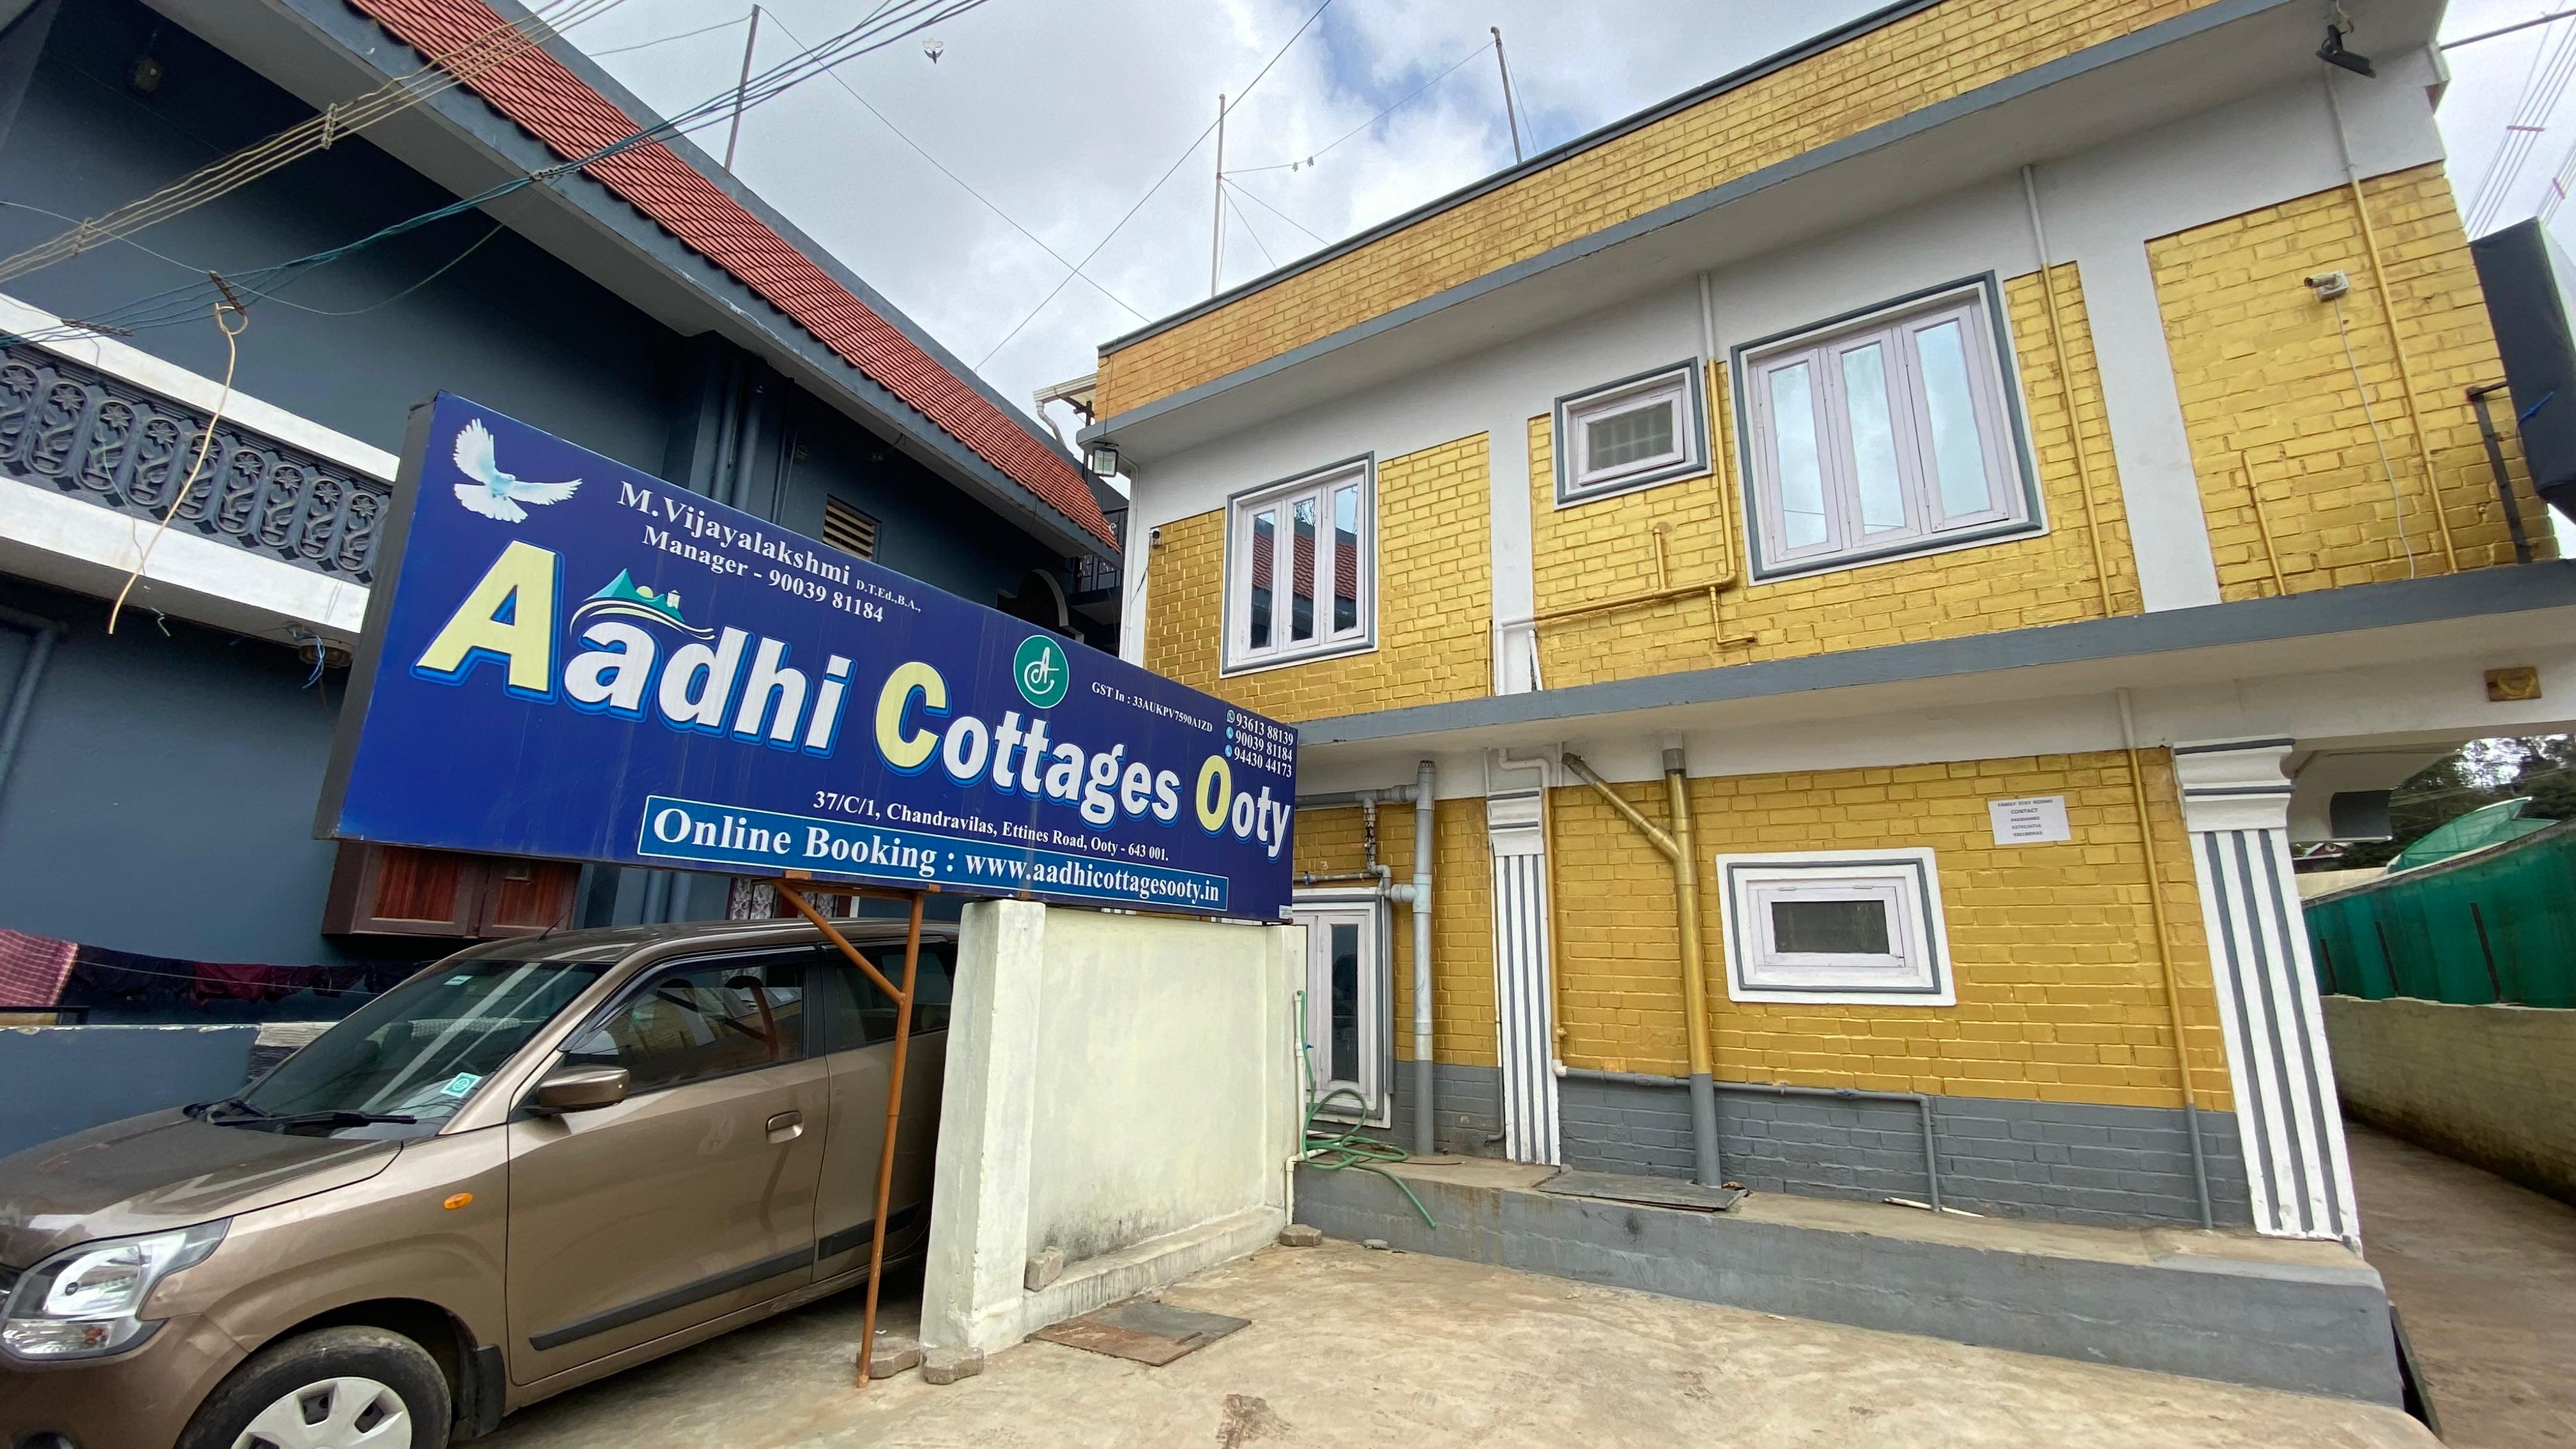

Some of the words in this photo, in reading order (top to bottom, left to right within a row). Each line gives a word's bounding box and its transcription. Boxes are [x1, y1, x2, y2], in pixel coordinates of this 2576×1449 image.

[617, 481, 850, 585] M.Vijayalakshmi
[642, 525, 748, 578] Manager
[768, 569, 827, 602] 90039
[832, 592, 883, 622] 81184
[414, 539, 855, 750] Aadhi
[875, 661, 1180, 825] Cottages
[1195, 755, 1291, 858] Ooty
[1091, 681, 1114, 698] GST
[1115, 689, 1125, 702] In
[1132, 696, 1213, 733] 33AUKPV7590A1ZD
[1236, 713, 1264, 735] 93613
[1267, 725, 1294, 746] 88139
[1234, 746, 1263, 769] 94430
[1265, 758, 1292, 778] 44173
[1236, 730, 1264, 751] 90039
[1266, 742, 1292, 762] 81184
[654, 808, 792, 854] Online
[802, 825, 937, 877] Booking
[965, 854, 1220, 905] www.aadhicottagesooty.in
[813, 791, 880, 821] 37/C/1,
[886, 803, 997, 837] Chandravilas,
[1002, 822, 1048, 842] Ettines
[1052, 831, 1087, 851] Road,
[1091, 837, 1119, 857] Ooty
[1128, 843, 1146, 859] 643
[1149, 847, 1169, 861] 001.
